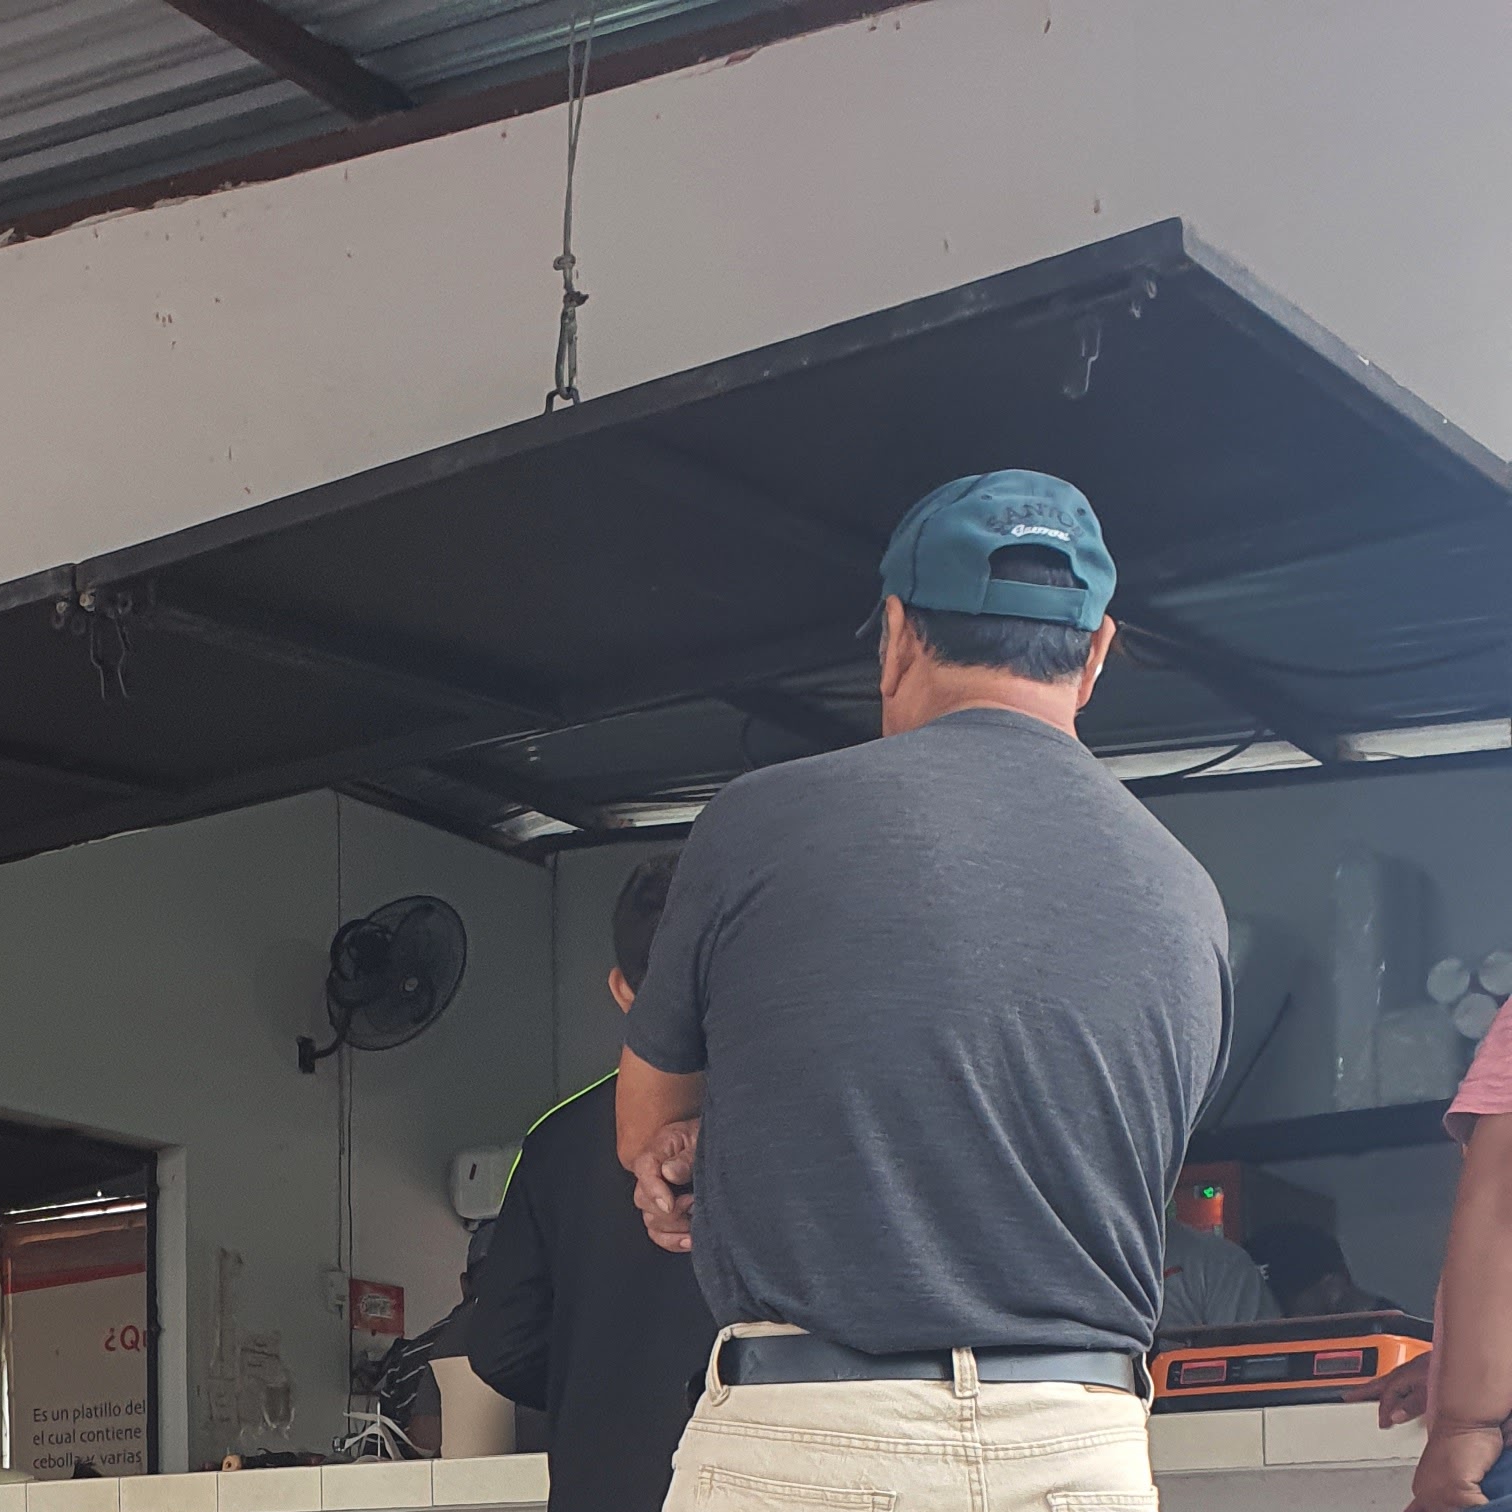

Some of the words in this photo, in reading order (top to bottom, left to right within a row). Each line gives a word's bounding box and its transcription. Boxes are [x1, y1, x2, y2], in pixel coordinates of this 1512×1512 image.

[104, 1325, 147, 1352] ¿Q
[33, 1408, 48, 1423] Es
[51, 1408, 69, 1422] un
[73, 1402, 121, 1424] platillo
[125, 1399, 146, 1415] del
[33, 1431, 44, 1446] el
[48, 1429, 76, 1446] cual
[80, 1426, 142, 1443] contiene
[100, 1450, 142, 1466] varias
